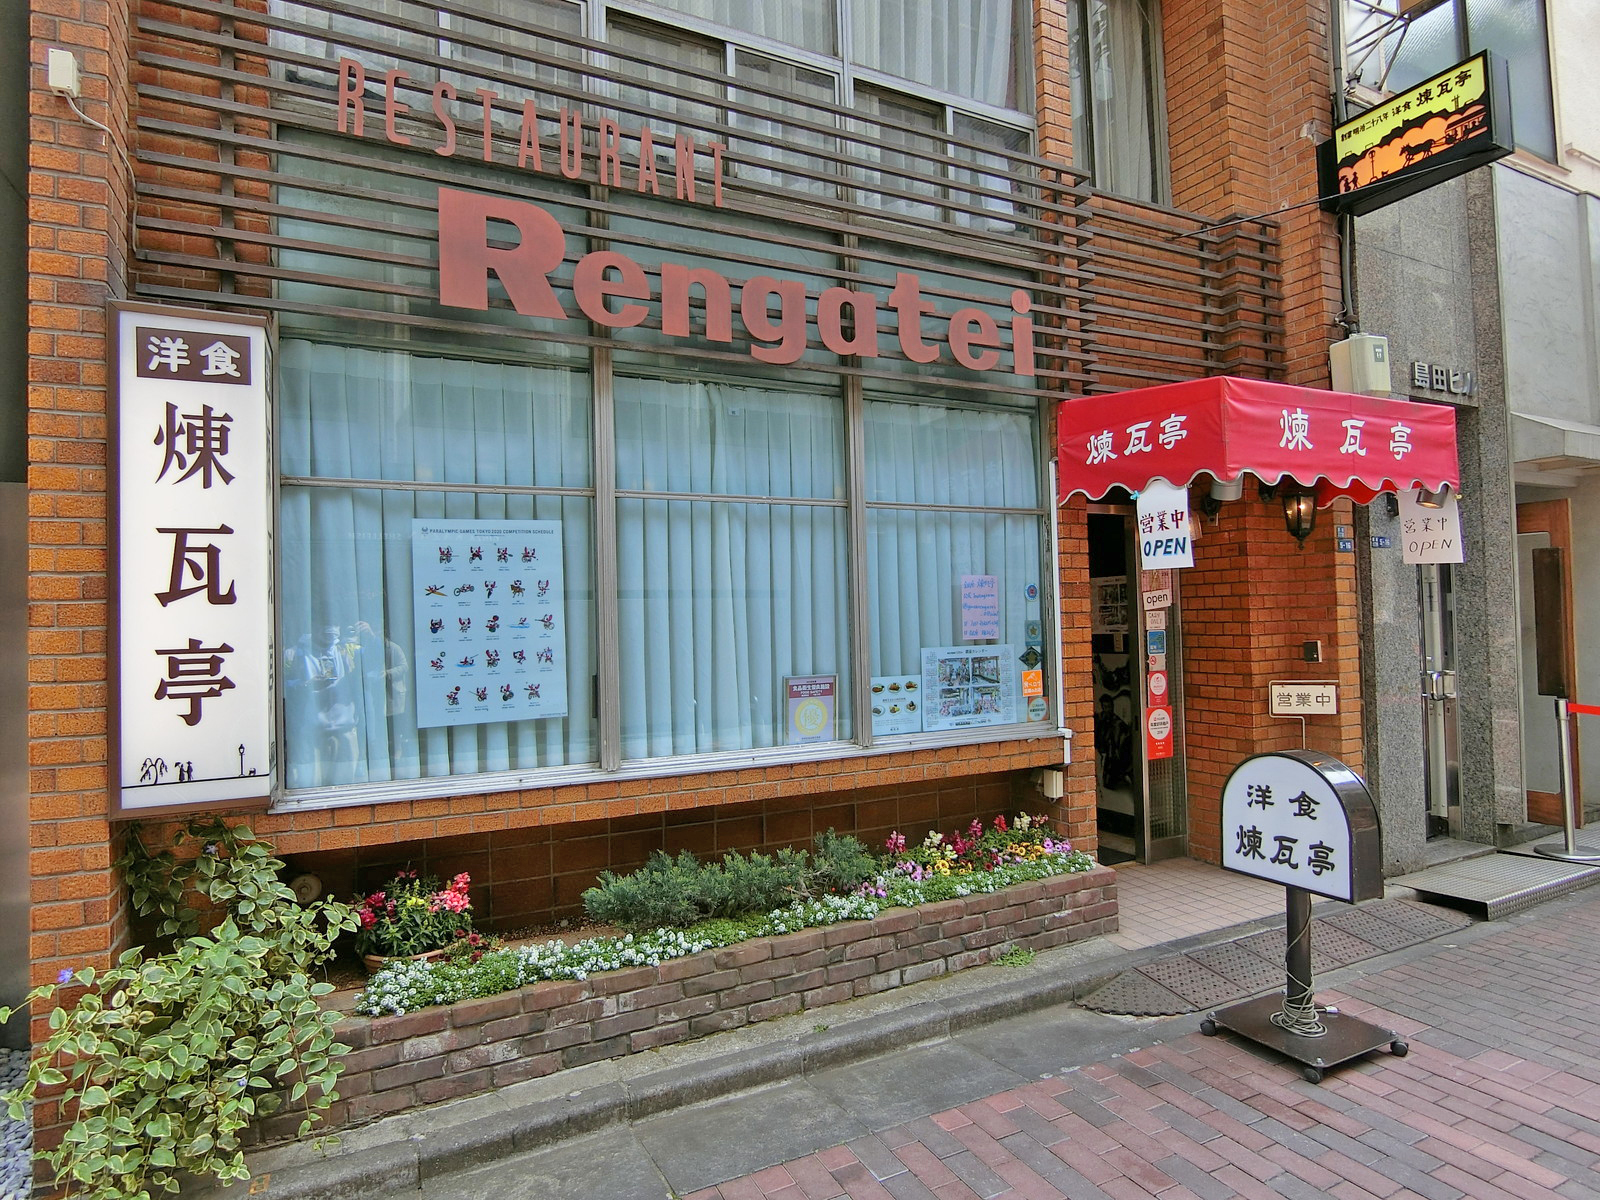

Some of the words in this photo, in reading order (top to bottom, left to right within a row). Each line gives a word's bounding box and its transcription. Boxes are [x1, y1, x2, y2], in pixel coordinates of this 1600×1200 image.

[1391, 101, 1412, 117] 洋食
[1415, 68, 1472, 108] 煉瓦亭
[337, 56, 727, 208] RESTAURANT
[438, 187, 1035, 377] Rengatei
[147, 335, 242, 378] 洋食
[1411, 361, 1479, 397] 島田ビル
[1086, 413, 1188, 465] 煉瓦亭
[1279, 407, 1413, 461] 煉瓦亭
[1139, 509, 1185, 535] 営業中
[1403, 517, 1448, 534] 営業中
[153, 401, 238, 727] 煉瓦亭
[1143, 537, 1187, 557] OPEN
[1146, 593, 1168, 606] open
[1276, 692, 1331, 708] 営業中
[1246, 784, 1321, 821] 洋食
[1235, 824, 1336, 876] 煉瓦亭
